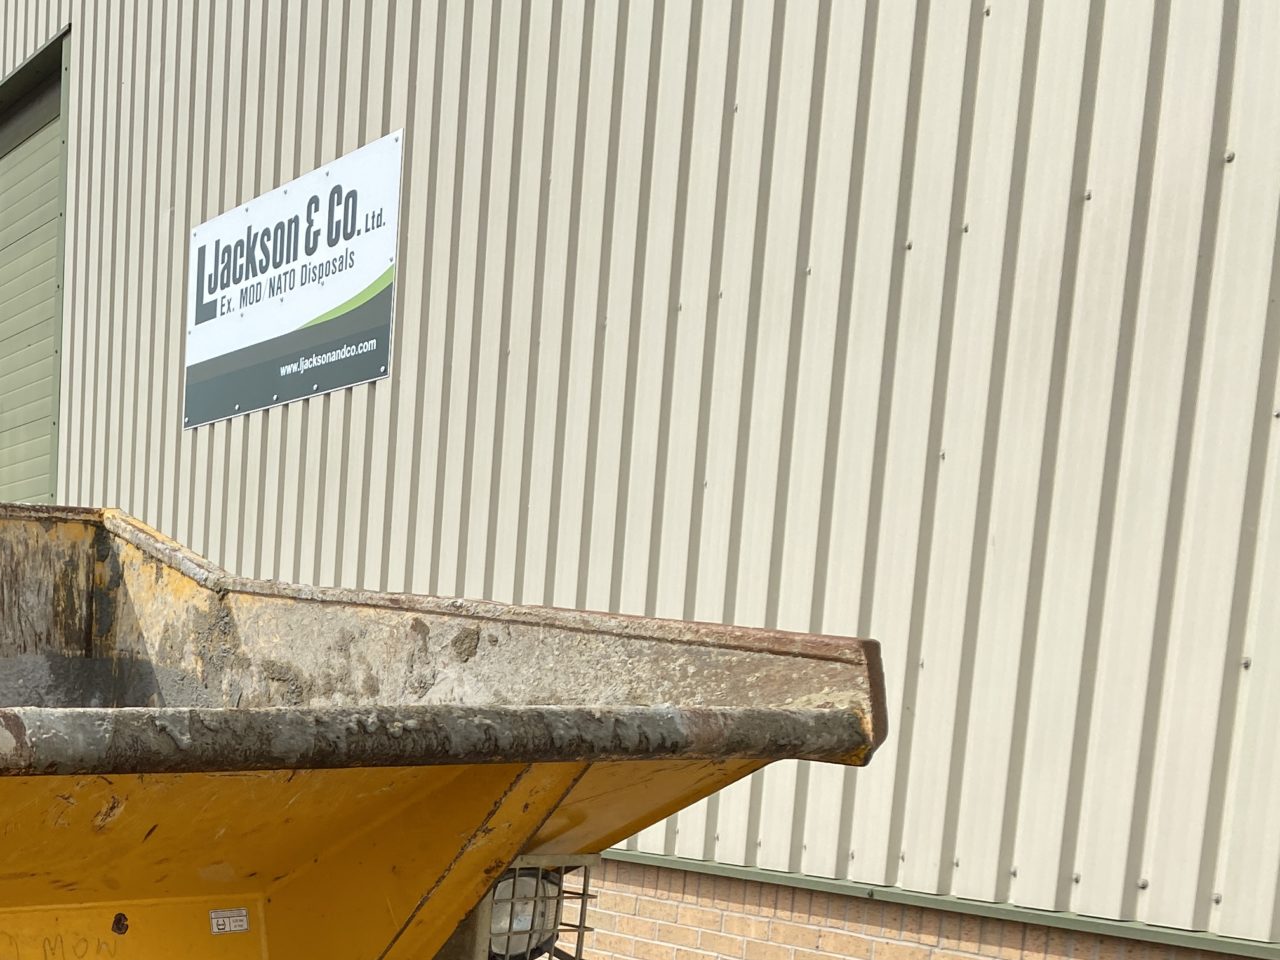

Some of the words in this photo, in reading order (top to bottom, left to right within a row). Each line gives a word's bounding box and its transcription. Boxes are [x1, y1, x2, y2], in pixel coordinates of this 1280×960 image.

[304, 194, 322, 257] &
[326, 184, 361, 248] Co.
[365, 207, 386, 234] Ltd.
[219, 294, 235, 317] Ex.
[239, 268, 296, 309] MOD/NATO
[300, 247, 355, 287] Disposals
[280, 338, 377, 377] www.ljacksonandco.com
